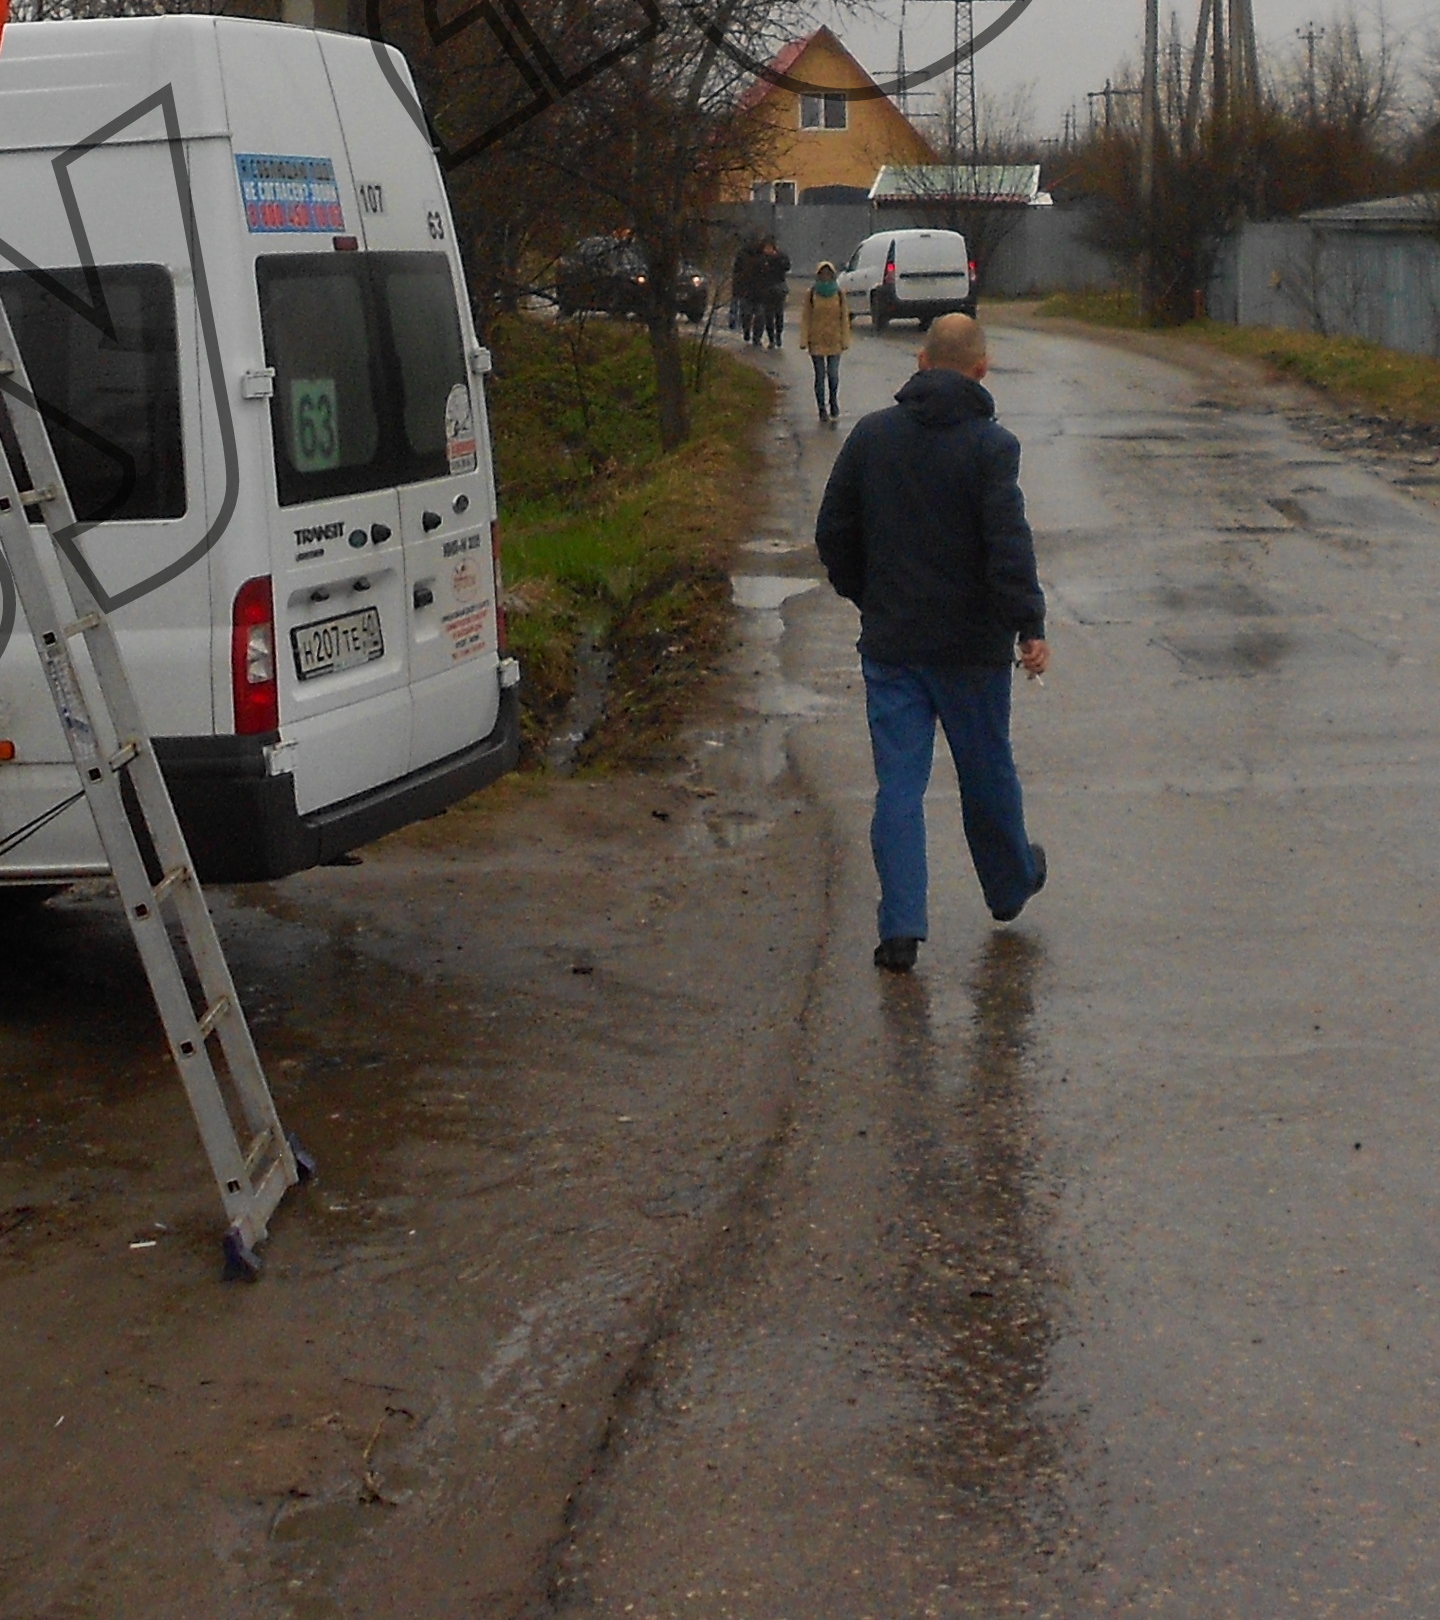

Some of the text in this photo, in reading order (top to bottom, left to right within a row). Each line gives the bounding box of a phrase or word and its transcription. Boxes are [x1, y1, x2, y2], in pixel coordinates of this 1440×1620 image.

[244, 181, 258, 201] НЕ
[259, 181, 309, 202] СОГЛАСЕН?
[360, 184, 384, 214] 107
[427, 210, 445, 240] 63
[299, 393, 335, 460] 63
[293, 520, 345, 546] TRANSIT
